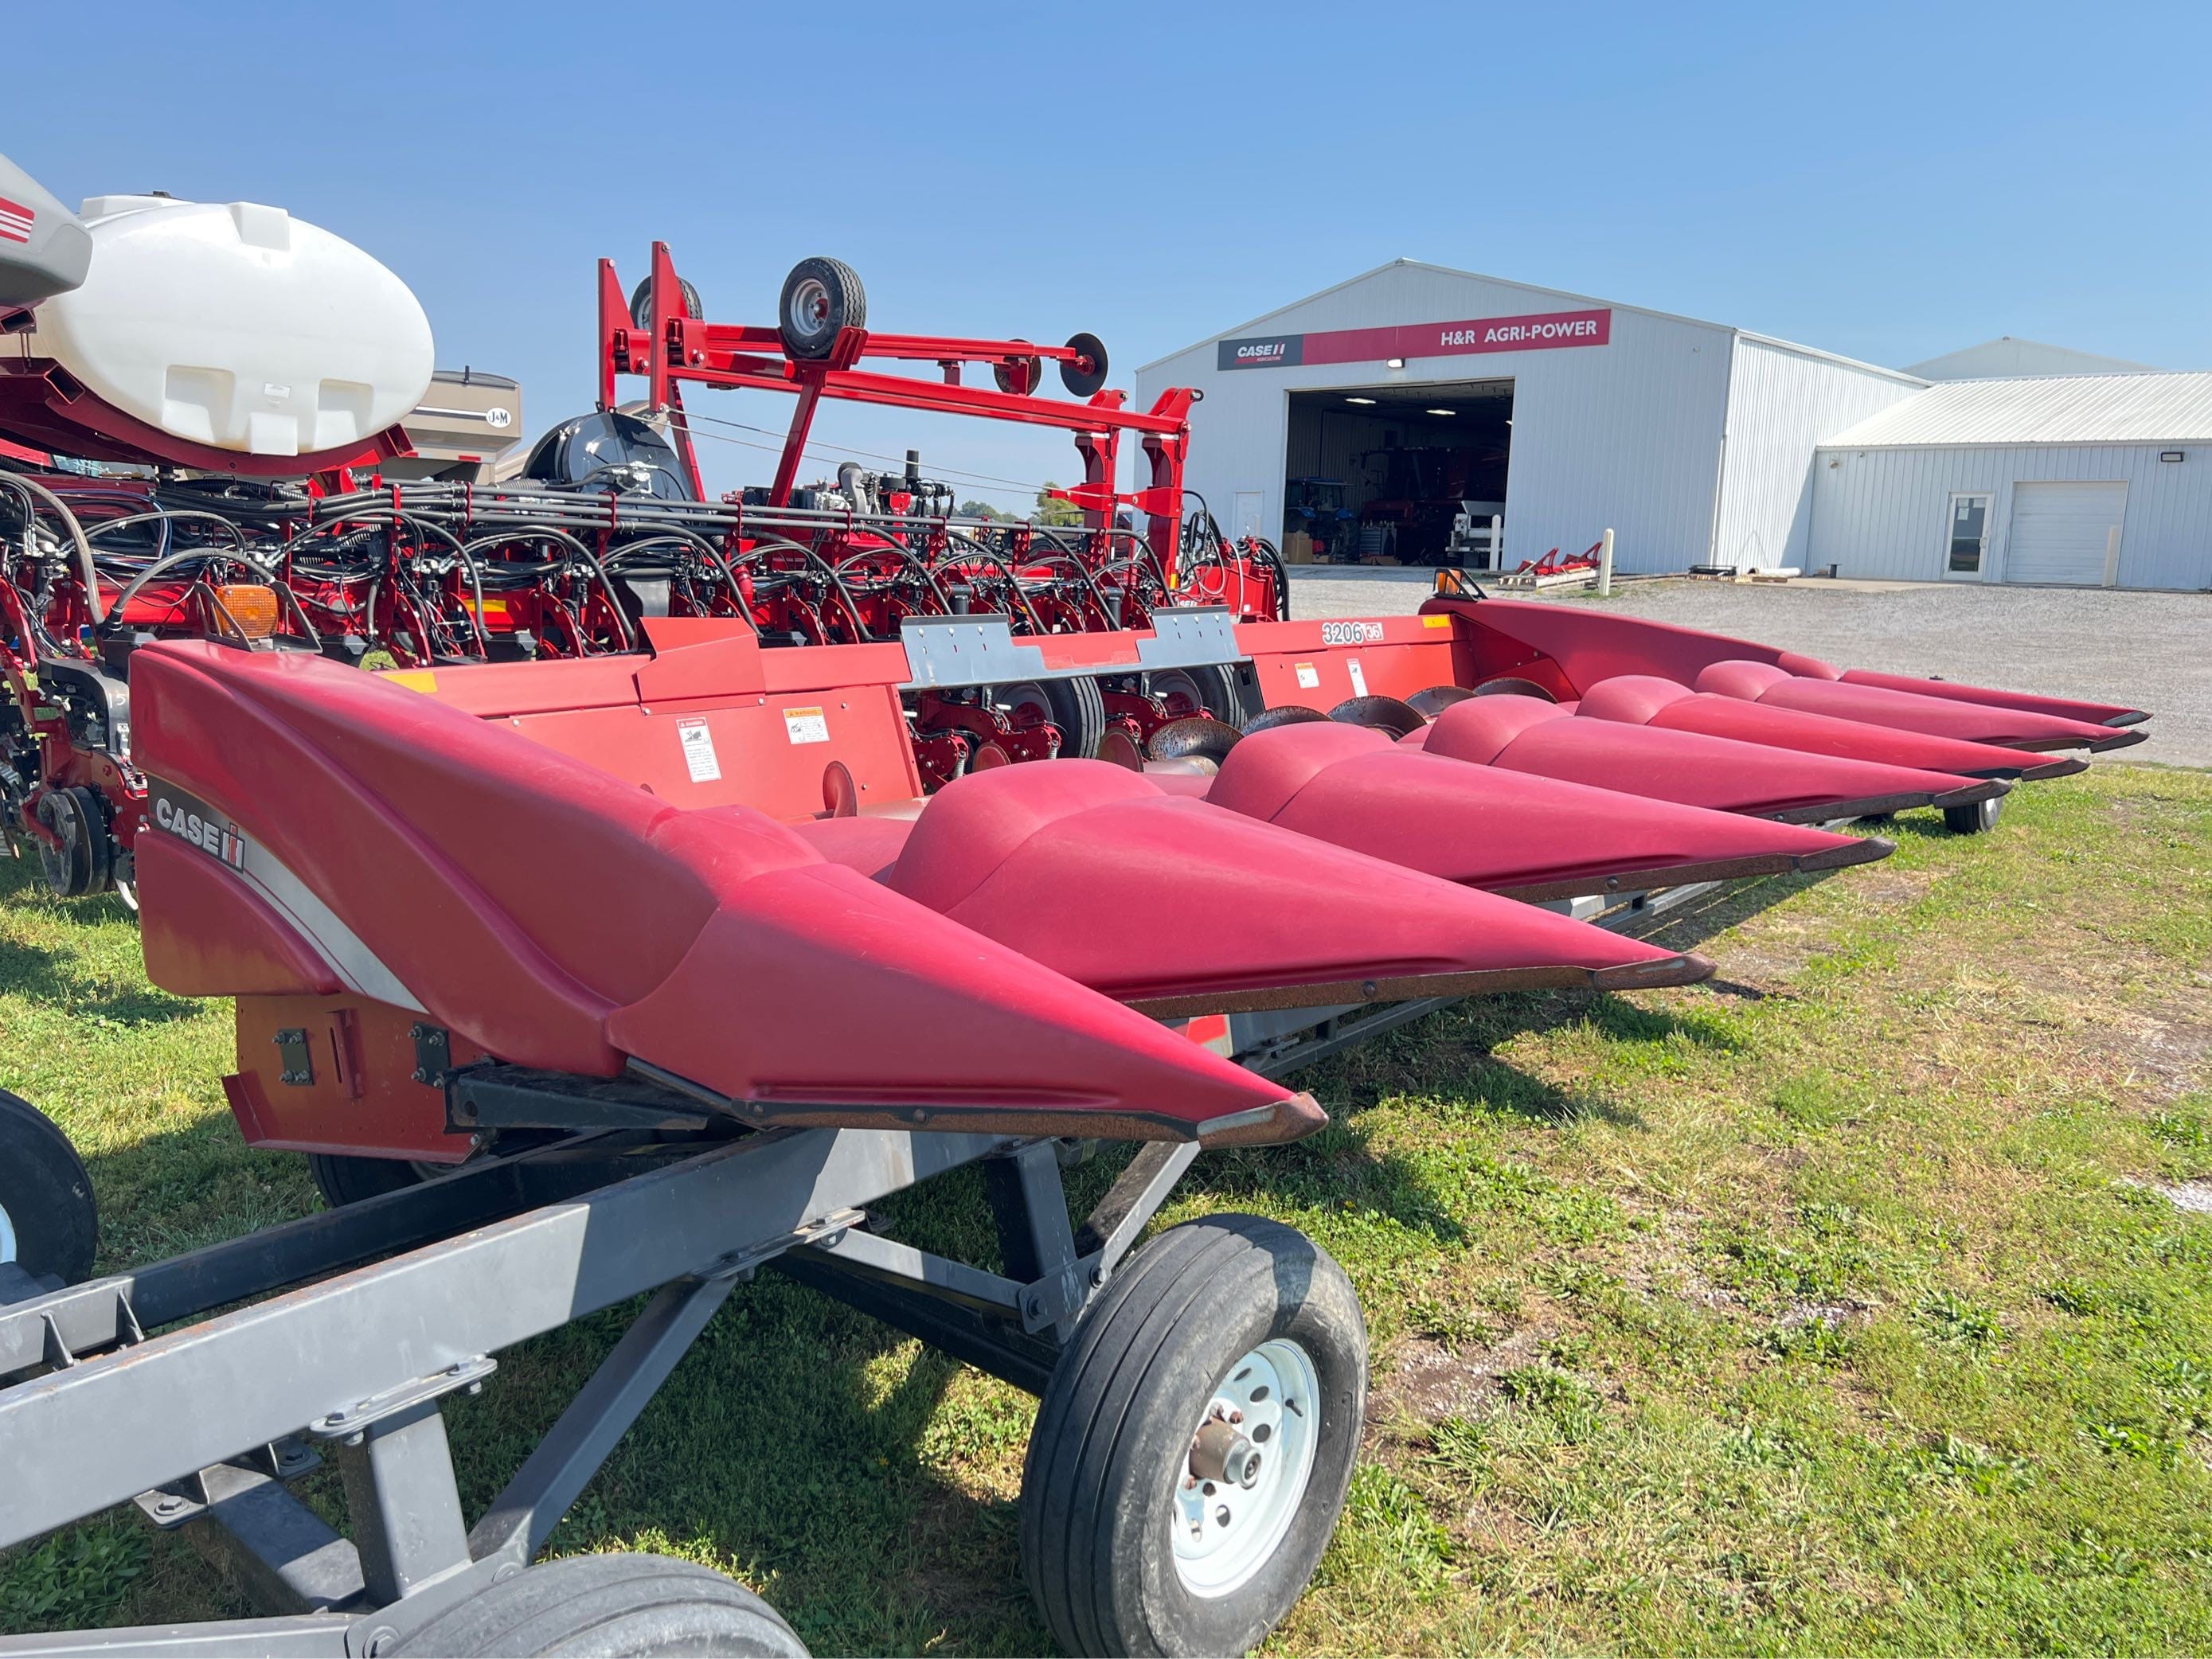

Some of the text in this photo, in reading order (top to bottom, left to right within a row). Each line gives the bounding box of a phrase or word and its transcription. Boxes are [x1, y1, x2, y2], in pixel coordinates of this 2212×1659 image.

[1440, 320, 1596, 345] H&R AGRI-POWER
[1237, 345, 1272, 358] CASE
[488, 411, 508, 424] J&M
[1323, 623, 1381, 644] 3206 36
[156, 798, 220, 857] CASE
